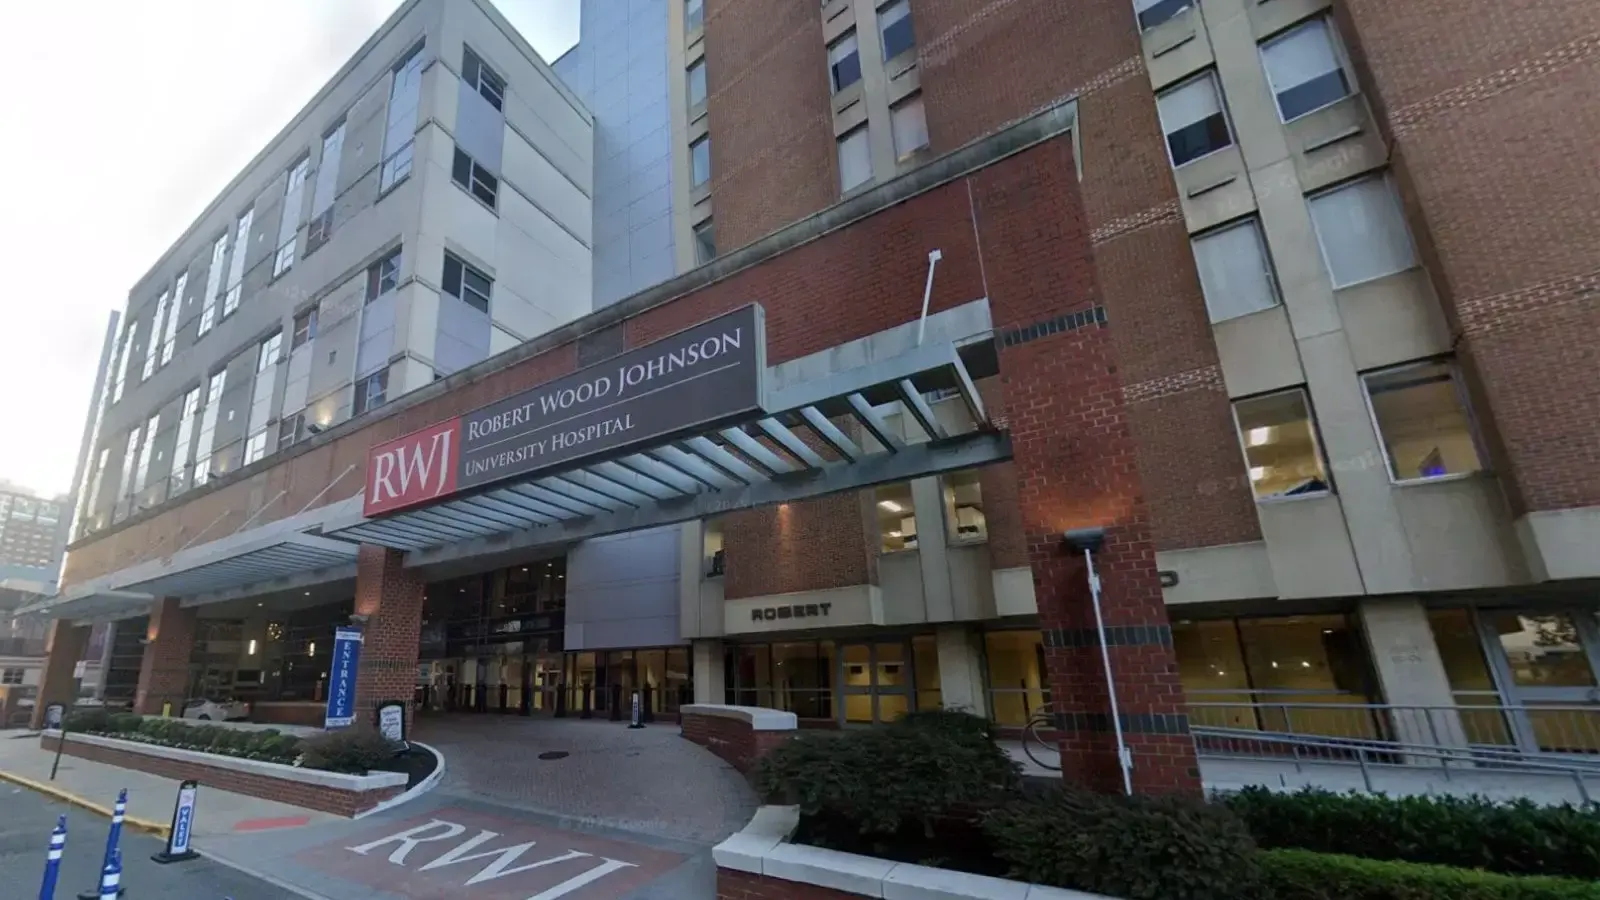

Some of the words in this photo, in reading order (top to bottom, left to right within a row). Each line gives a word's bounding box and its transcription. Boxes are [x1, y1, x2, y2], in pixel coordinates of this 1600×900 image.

[467, 402, 535, 441] ROBERT
[540, 377, 611, 415] WOOD
[617, 327, 742, 396] JOHNSON
[370, 428, 453, 504] RWJ
[465, 439, 547, 477] UNIVERSITY
[551, 413, 635, 451] HOSPITAL
[751, 602, 832, 621] ROBERT
[336, 641, 351, 716] ENTRANCE
[177, 808, 189, 846] VALET
[344, 818, 640, 900] RWJ
